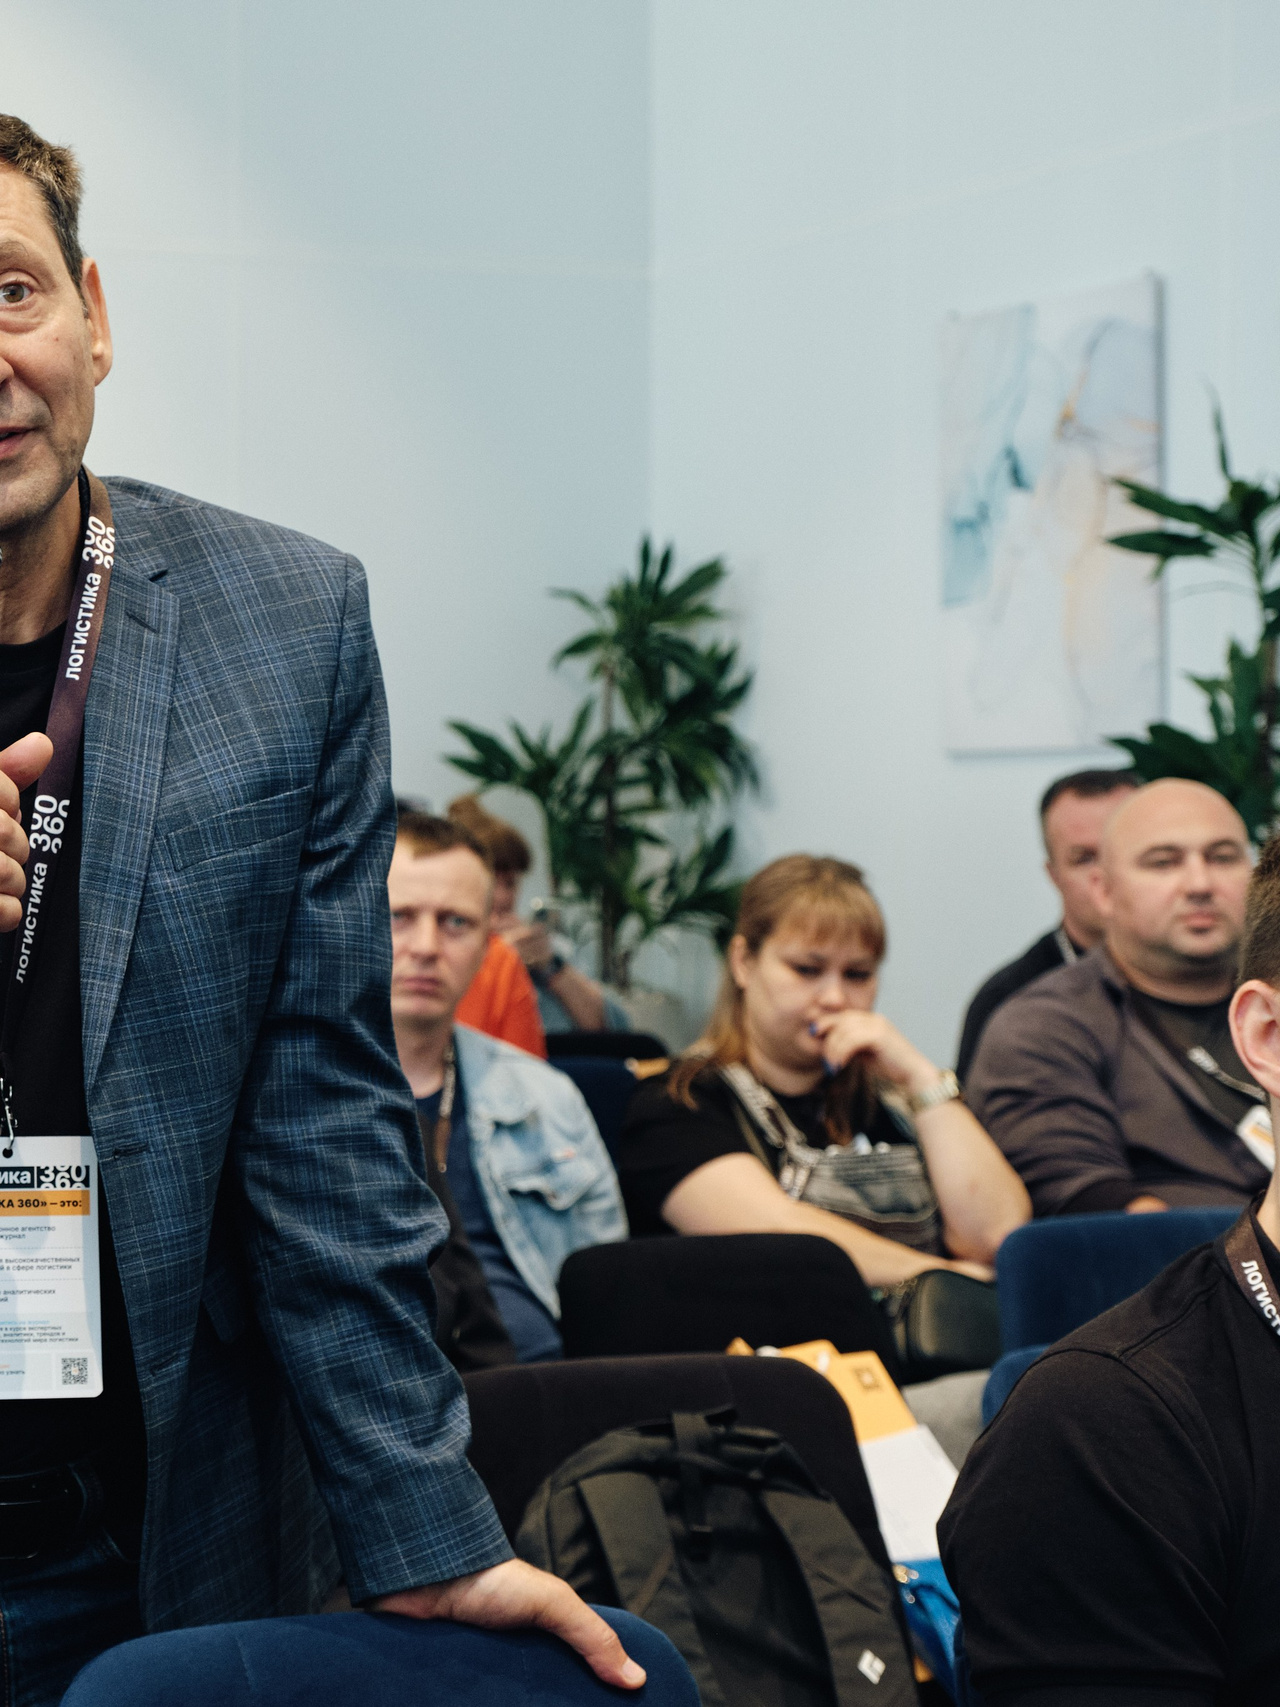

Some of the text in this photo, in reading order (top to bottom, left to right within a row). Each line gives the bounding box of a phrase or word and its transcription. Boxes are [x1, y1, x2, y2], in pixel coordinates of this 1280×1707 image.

[65, 572, 101, 680] логистика
[16, 862, 48, 984] логистика
[18, 1199, 47, 1208] 360»
